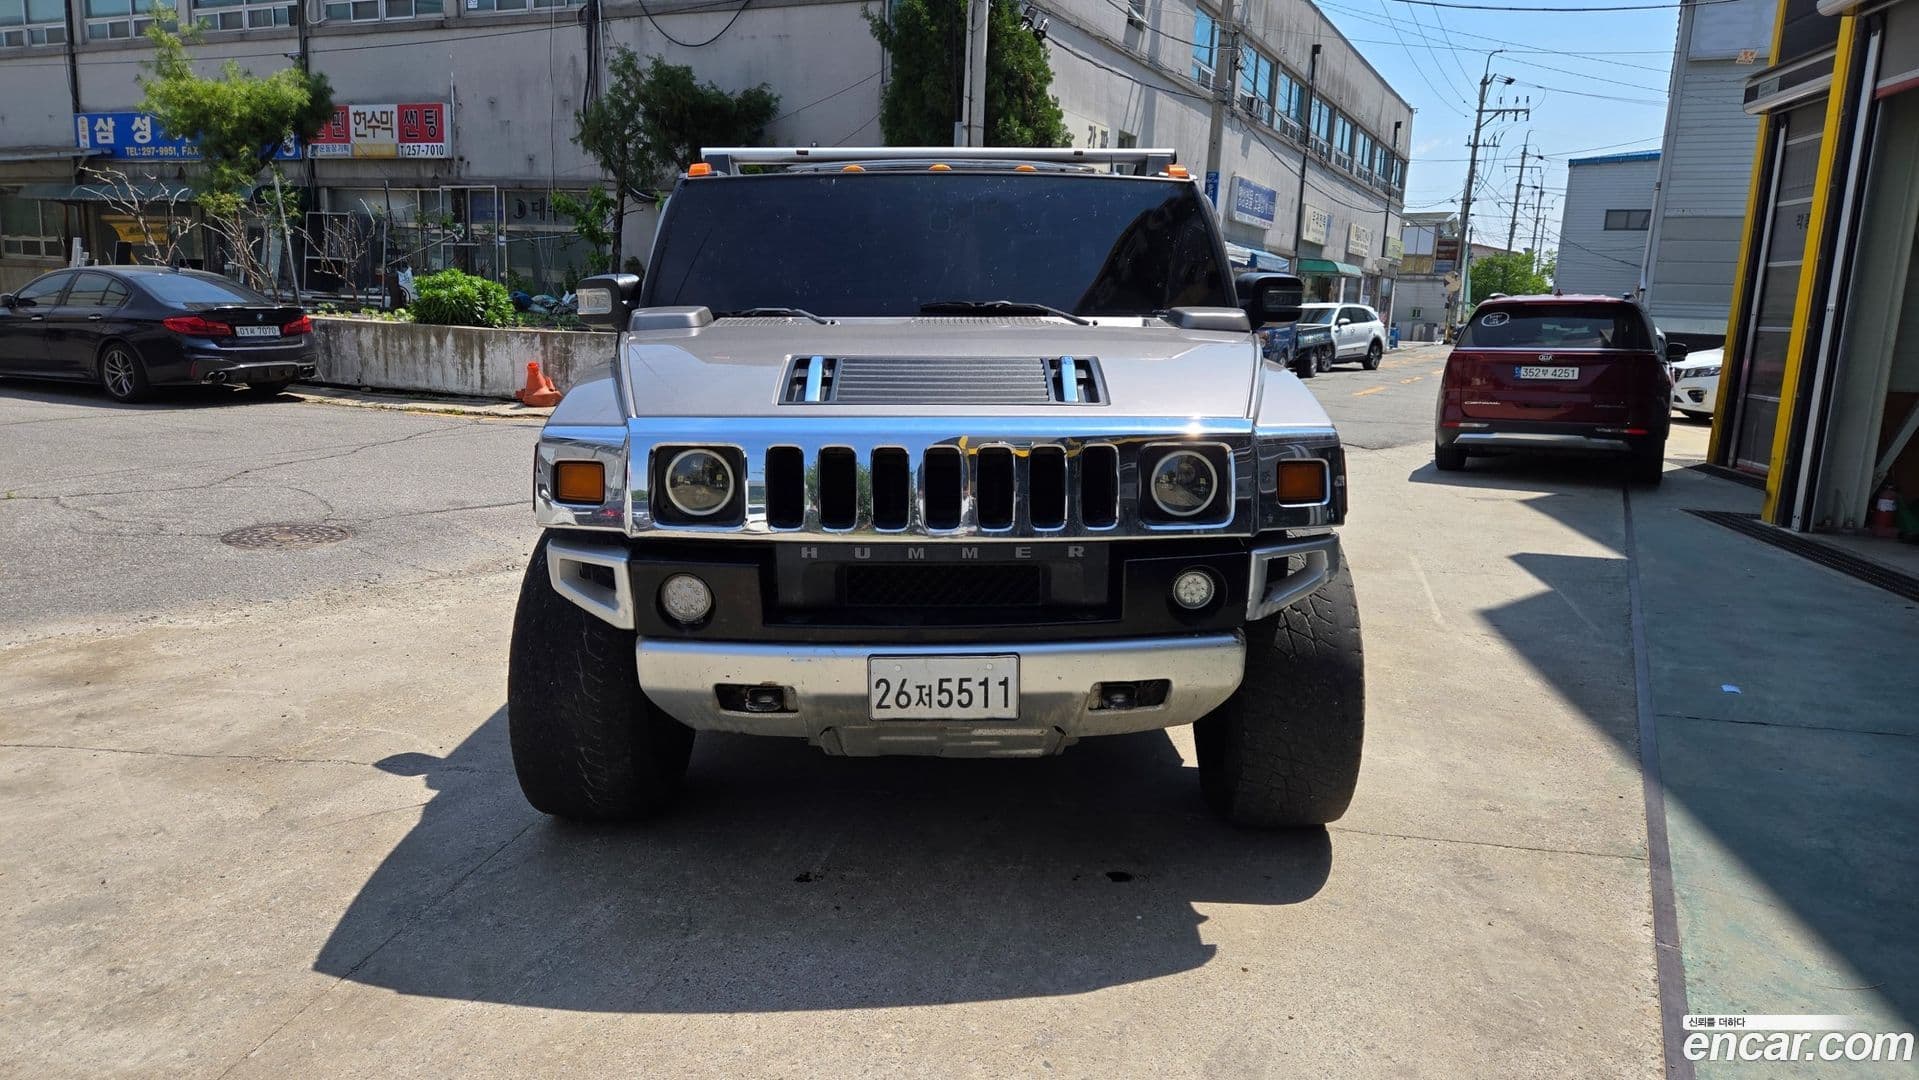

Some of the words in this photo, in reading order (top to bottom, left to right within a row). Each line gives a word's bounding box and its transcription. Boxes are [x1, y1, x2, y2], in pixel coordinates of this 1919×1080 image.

[1551, 368, 1575, 378] 4251
[801, 546, 1085, 560] HUMMER
[874, 677, 1009, 709] 26저5511
